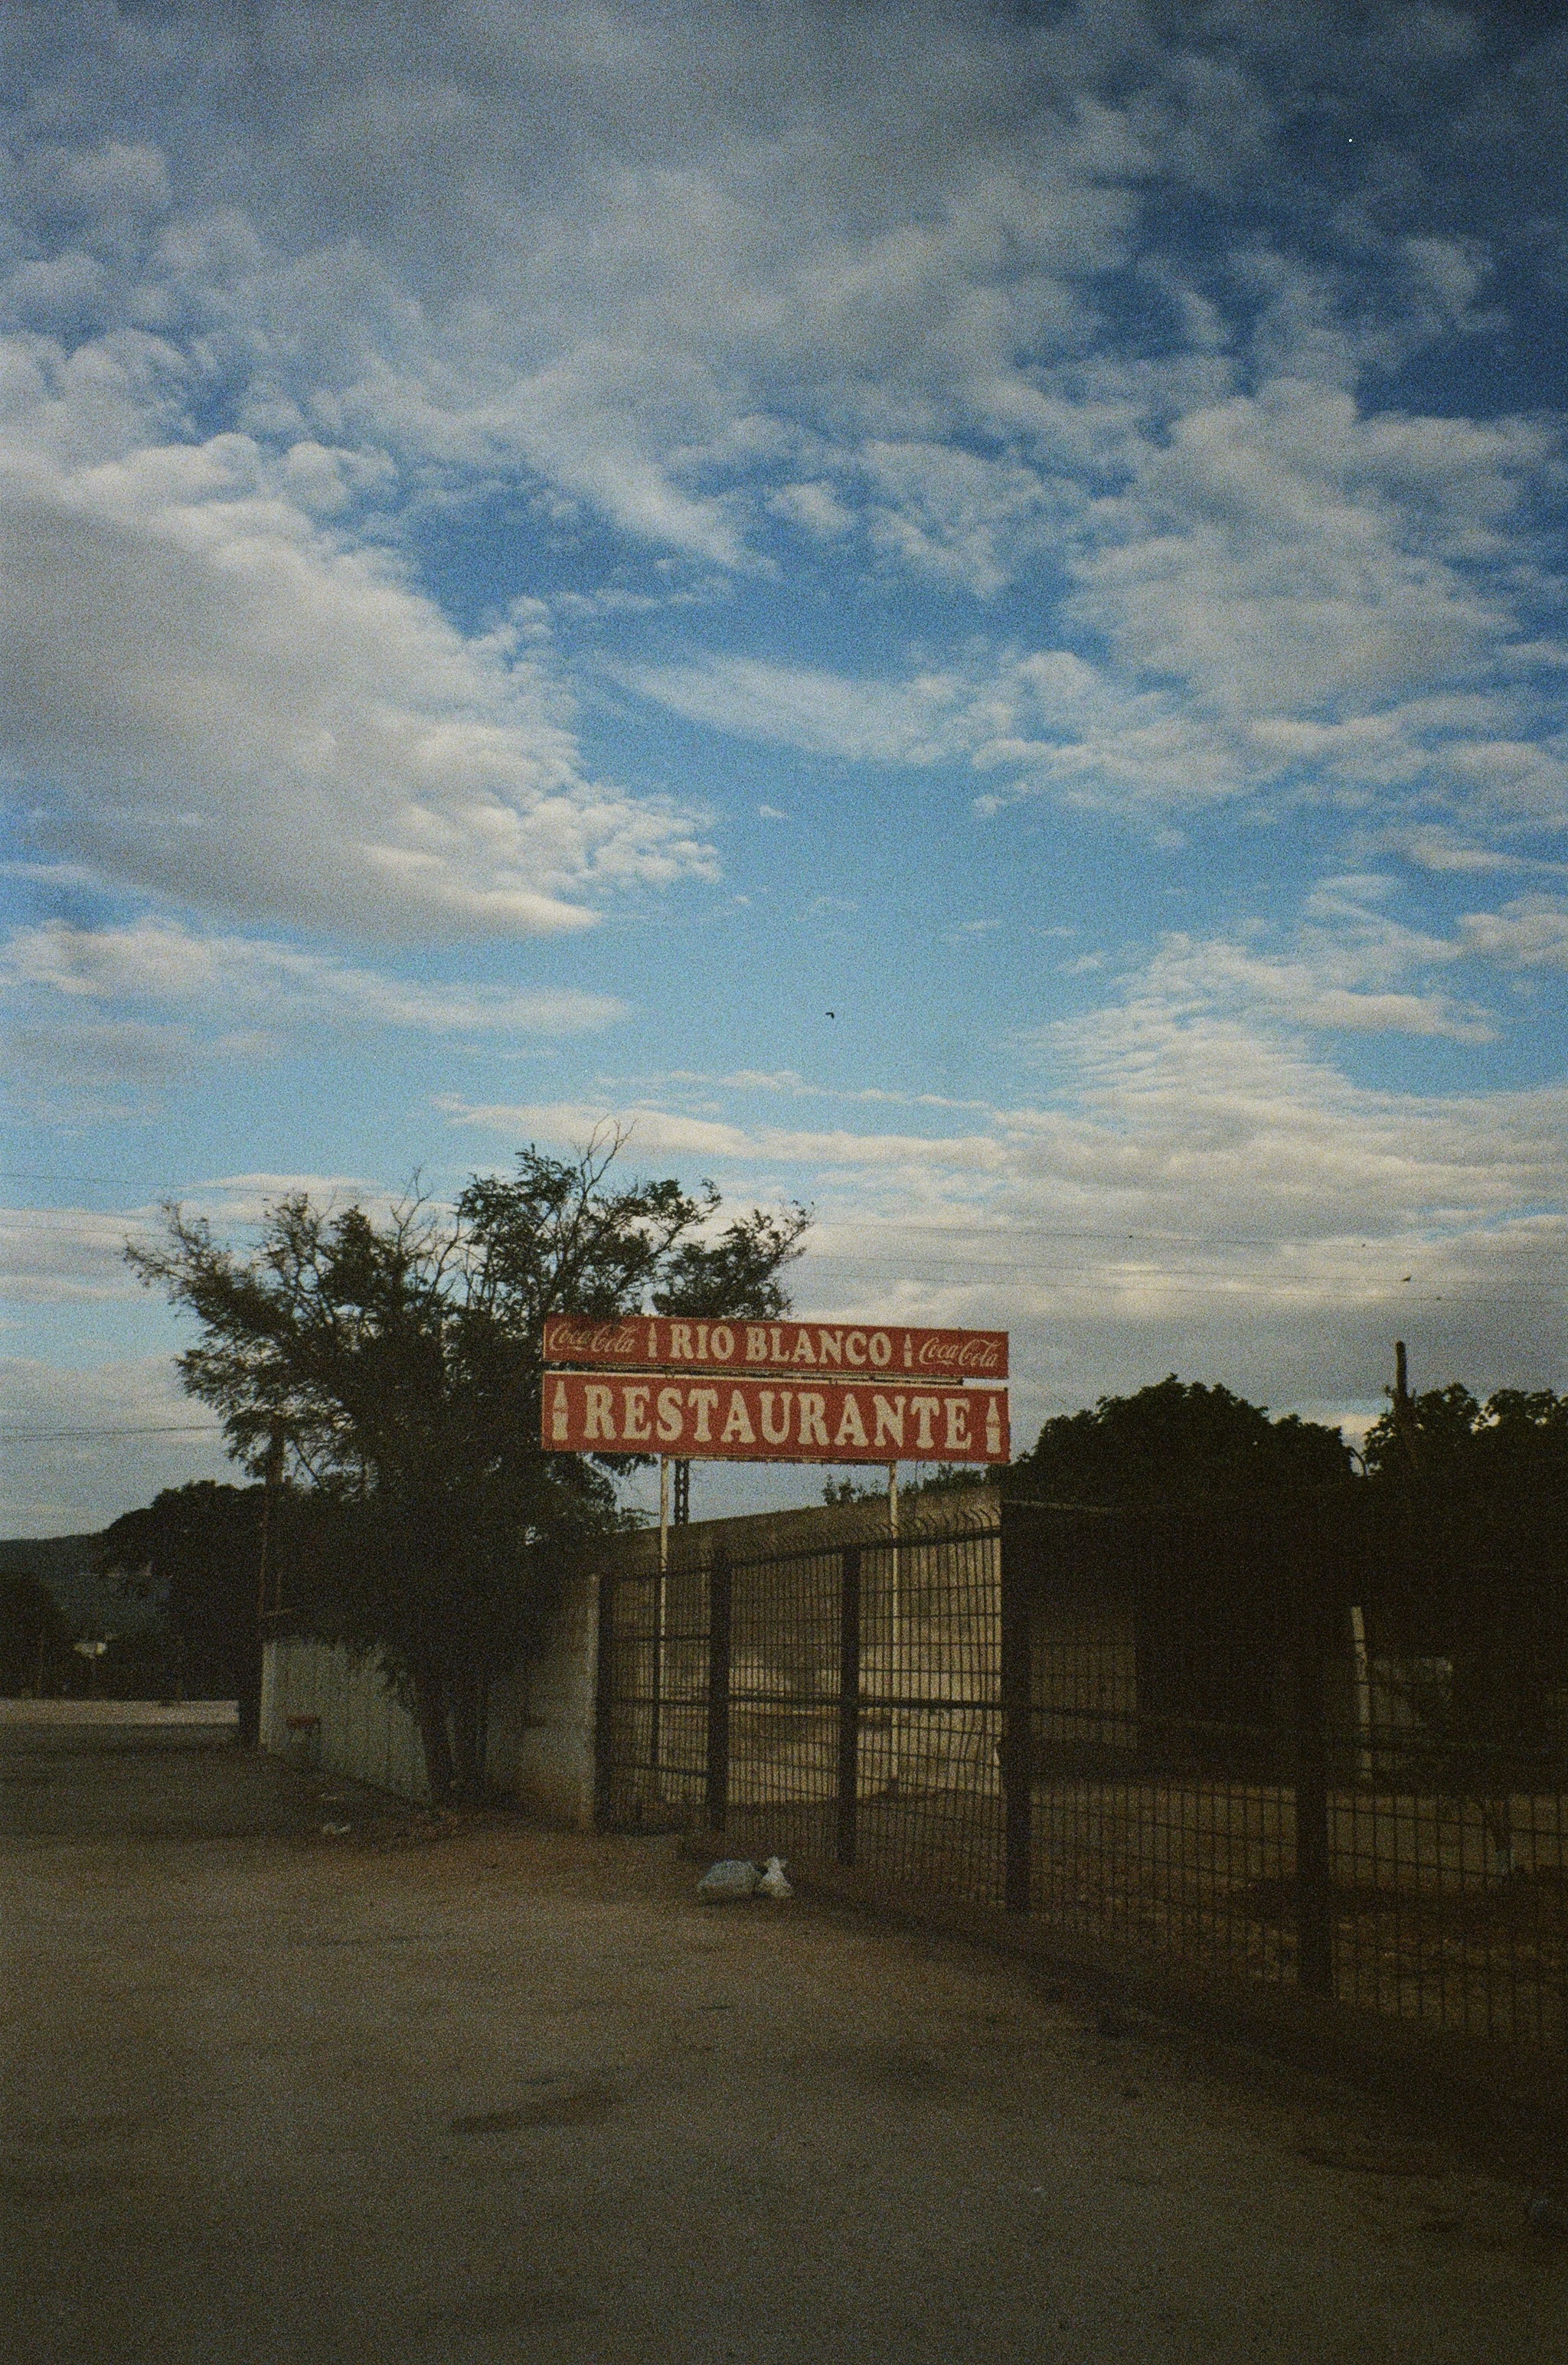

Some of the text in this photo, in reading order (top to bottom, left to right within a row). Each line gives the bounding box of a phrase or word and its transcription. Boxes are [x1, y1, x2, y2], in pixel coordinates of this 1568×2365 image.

[669, 1324, 892, 1367] RIO BLANCO
[584, 1384, 972, 1449] RESTAURANTE
